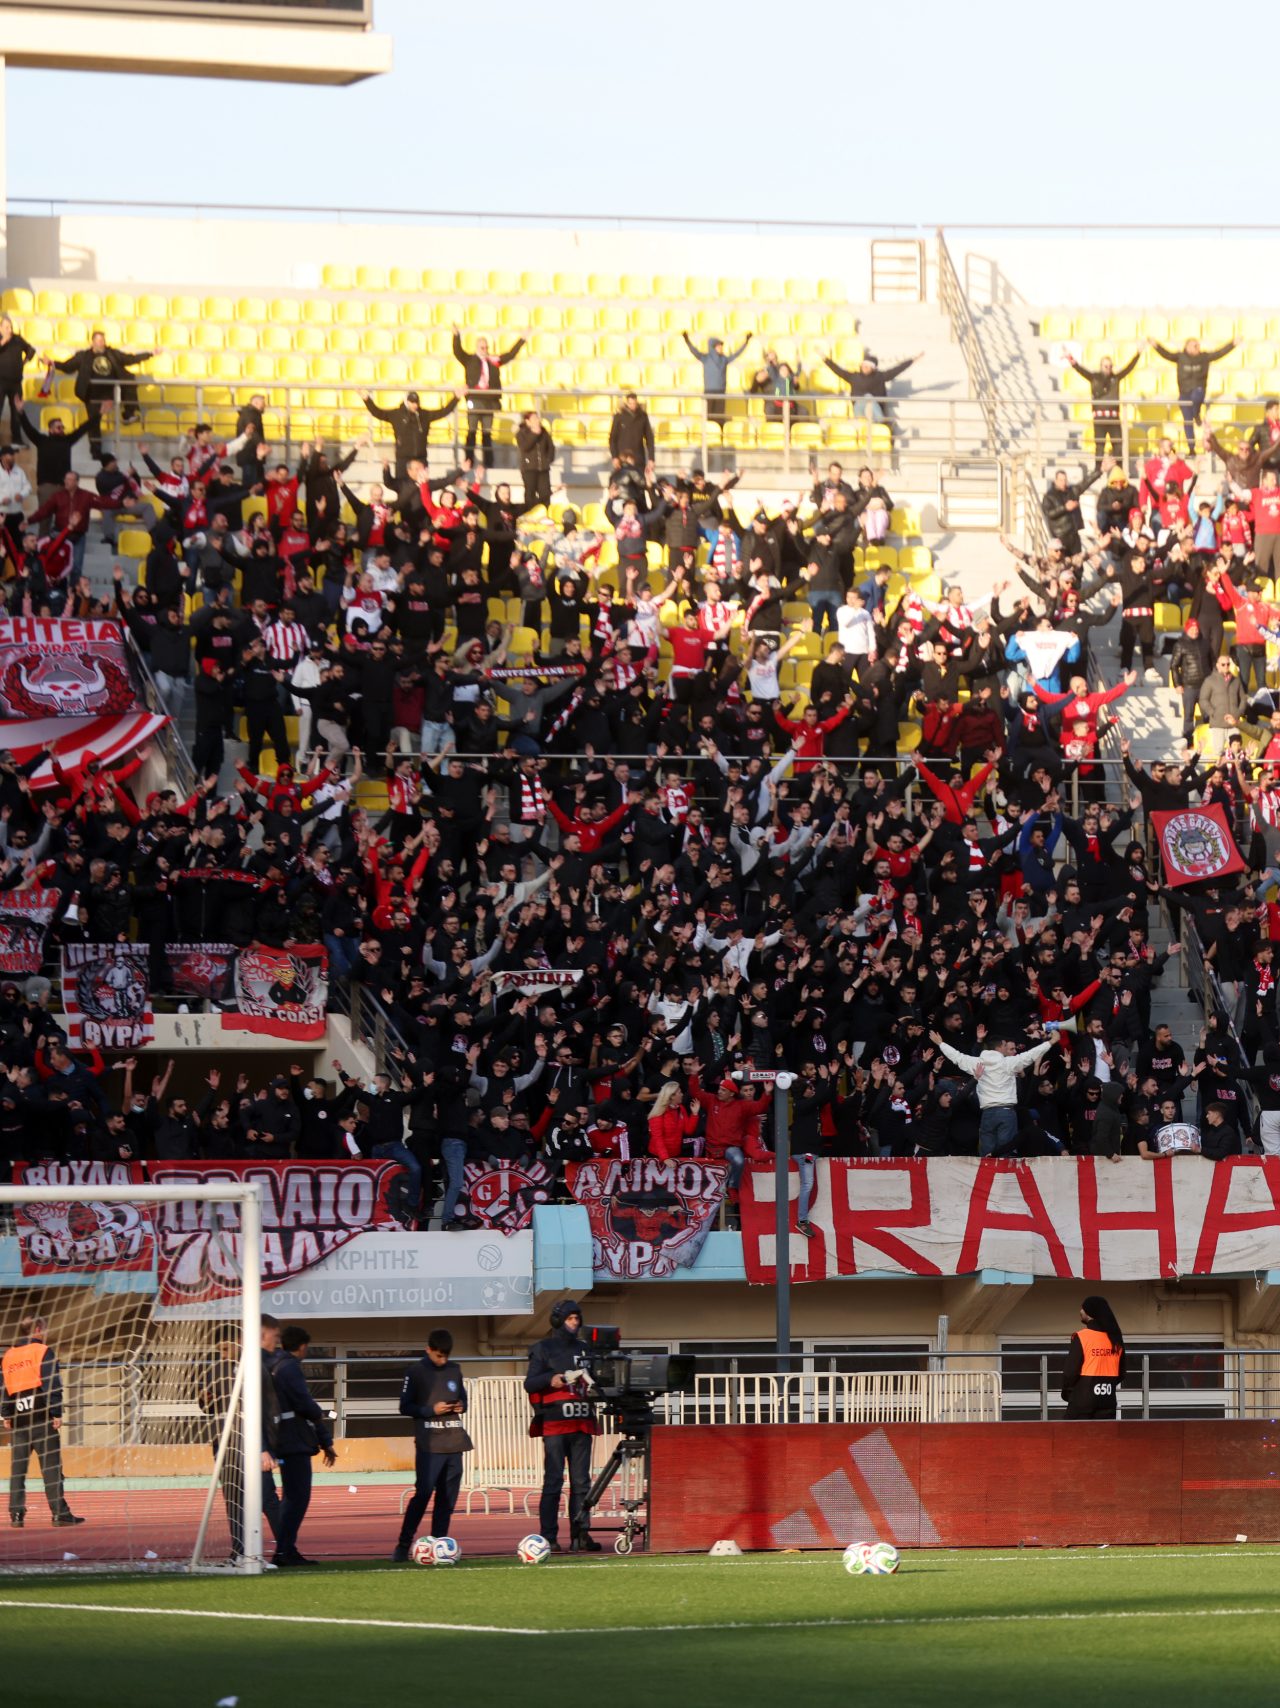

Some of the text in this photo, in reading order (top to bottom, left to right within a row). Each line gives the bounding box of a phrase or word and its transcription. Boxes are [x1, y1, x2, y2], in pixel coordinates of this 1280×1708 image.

[28, 643, 71, 655] ΘΥΡΑ
[575, 1158, 727, 1200] ΑΛΙΜΟΣ
[29, 1228, 144, 1262] ΘΥΡΑ 7
[336, 1250, 419, 1271] ΚΡΗΤΗΣ
[271, 1281, 454, 1311] στον αθλητισμό!
[1091, 1348, 1120, 1357] SECUR
[1093, 1382, 1112, 1396] 650
[16, 1395, 35, 1412] 617
[562, 1402, 590, 1417] 033
[424, 1420, 445, 1429] BALL
